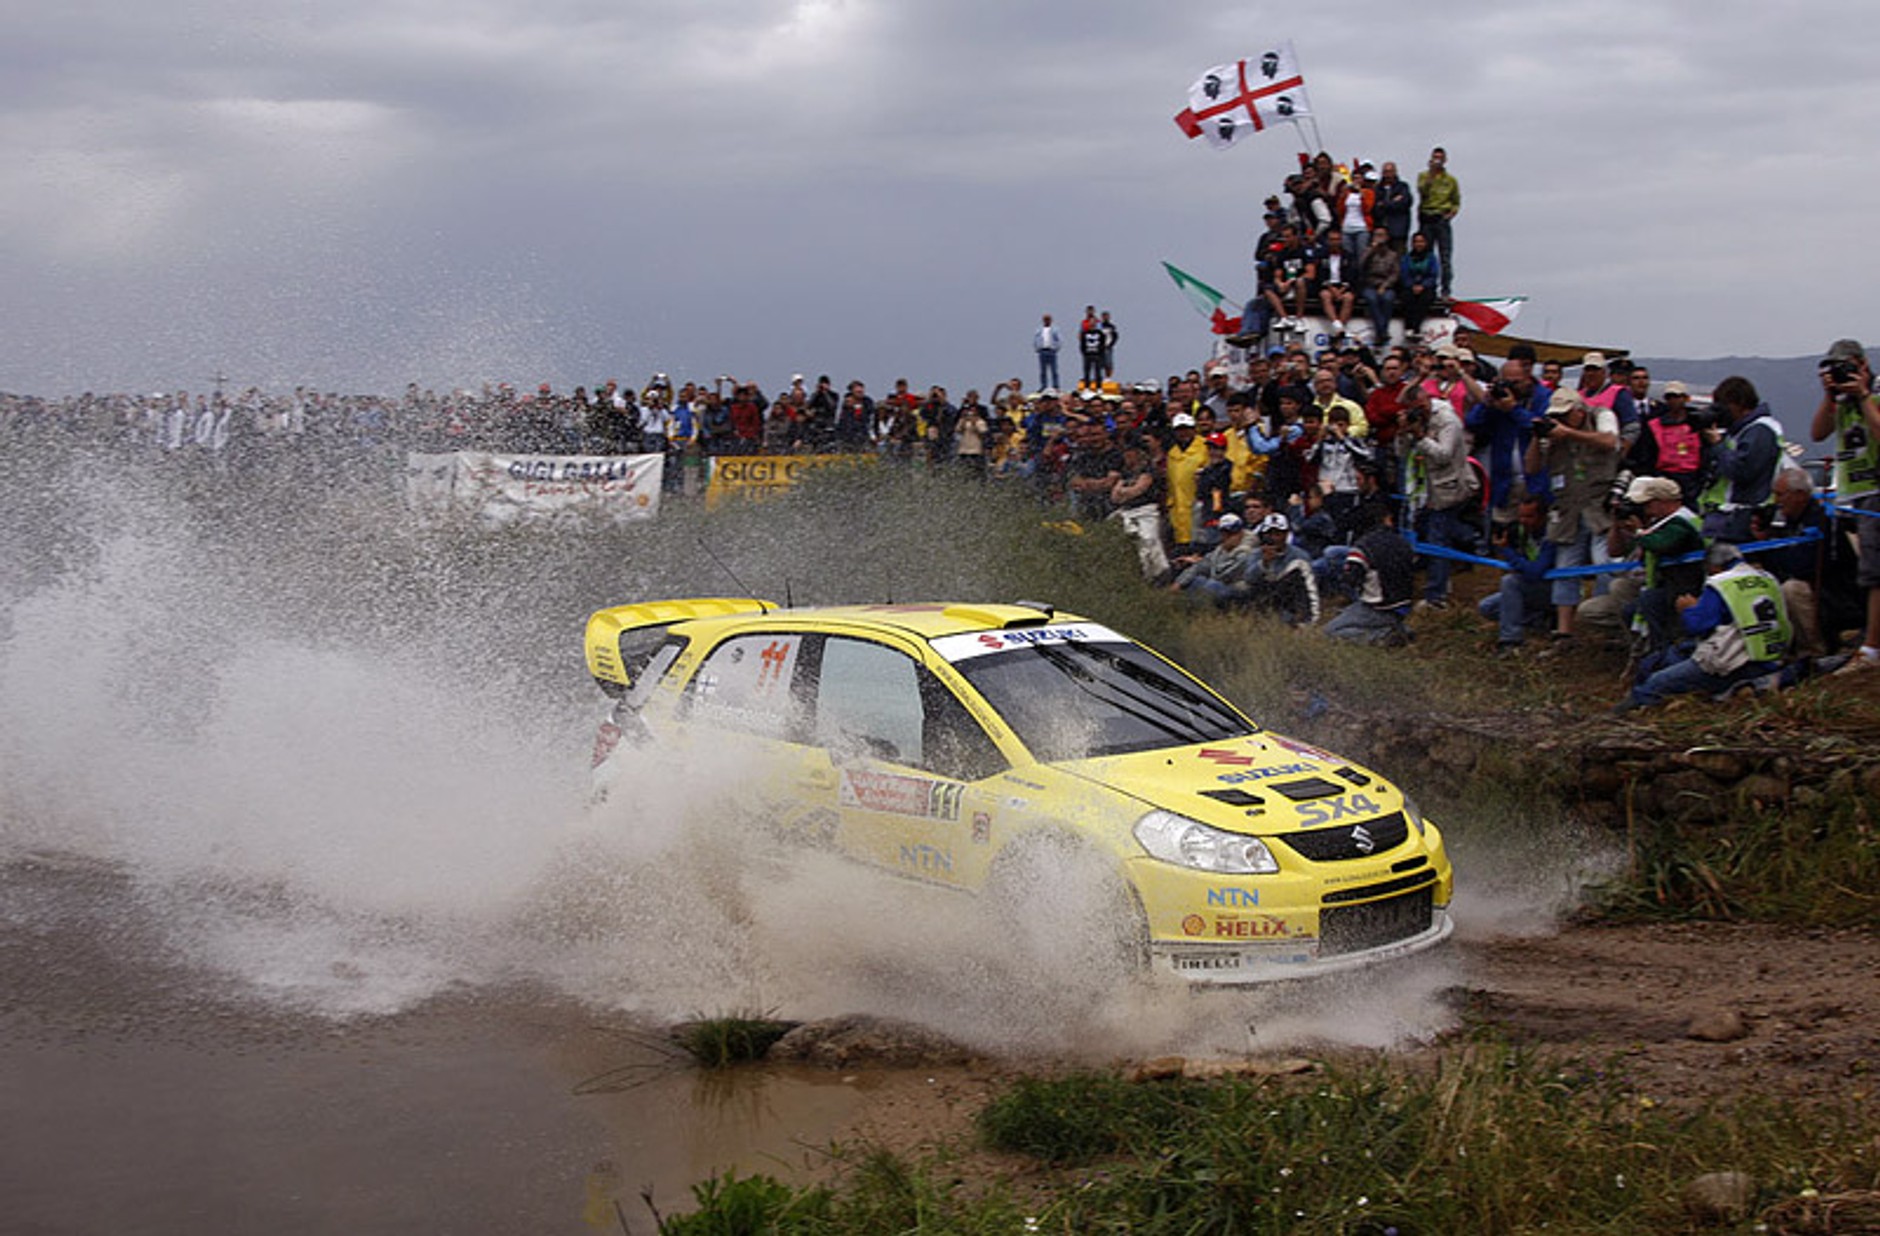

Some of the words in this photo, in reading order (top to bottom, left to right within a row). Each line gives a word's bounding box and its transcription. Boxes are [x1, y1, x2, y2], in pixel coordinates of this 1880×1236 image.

[509, 460, 555, 481] GIGI
[720, 460, 777, 482] GIGI
[1003, 628, 1089, 645] SUZUKI
[1216, 762, 1320, 784] SUZUKI
[1294, 793, 1381, 828] SX4
[900, 844, 953, 872] NTN
[1207, 887, 1259, 907] NTN
